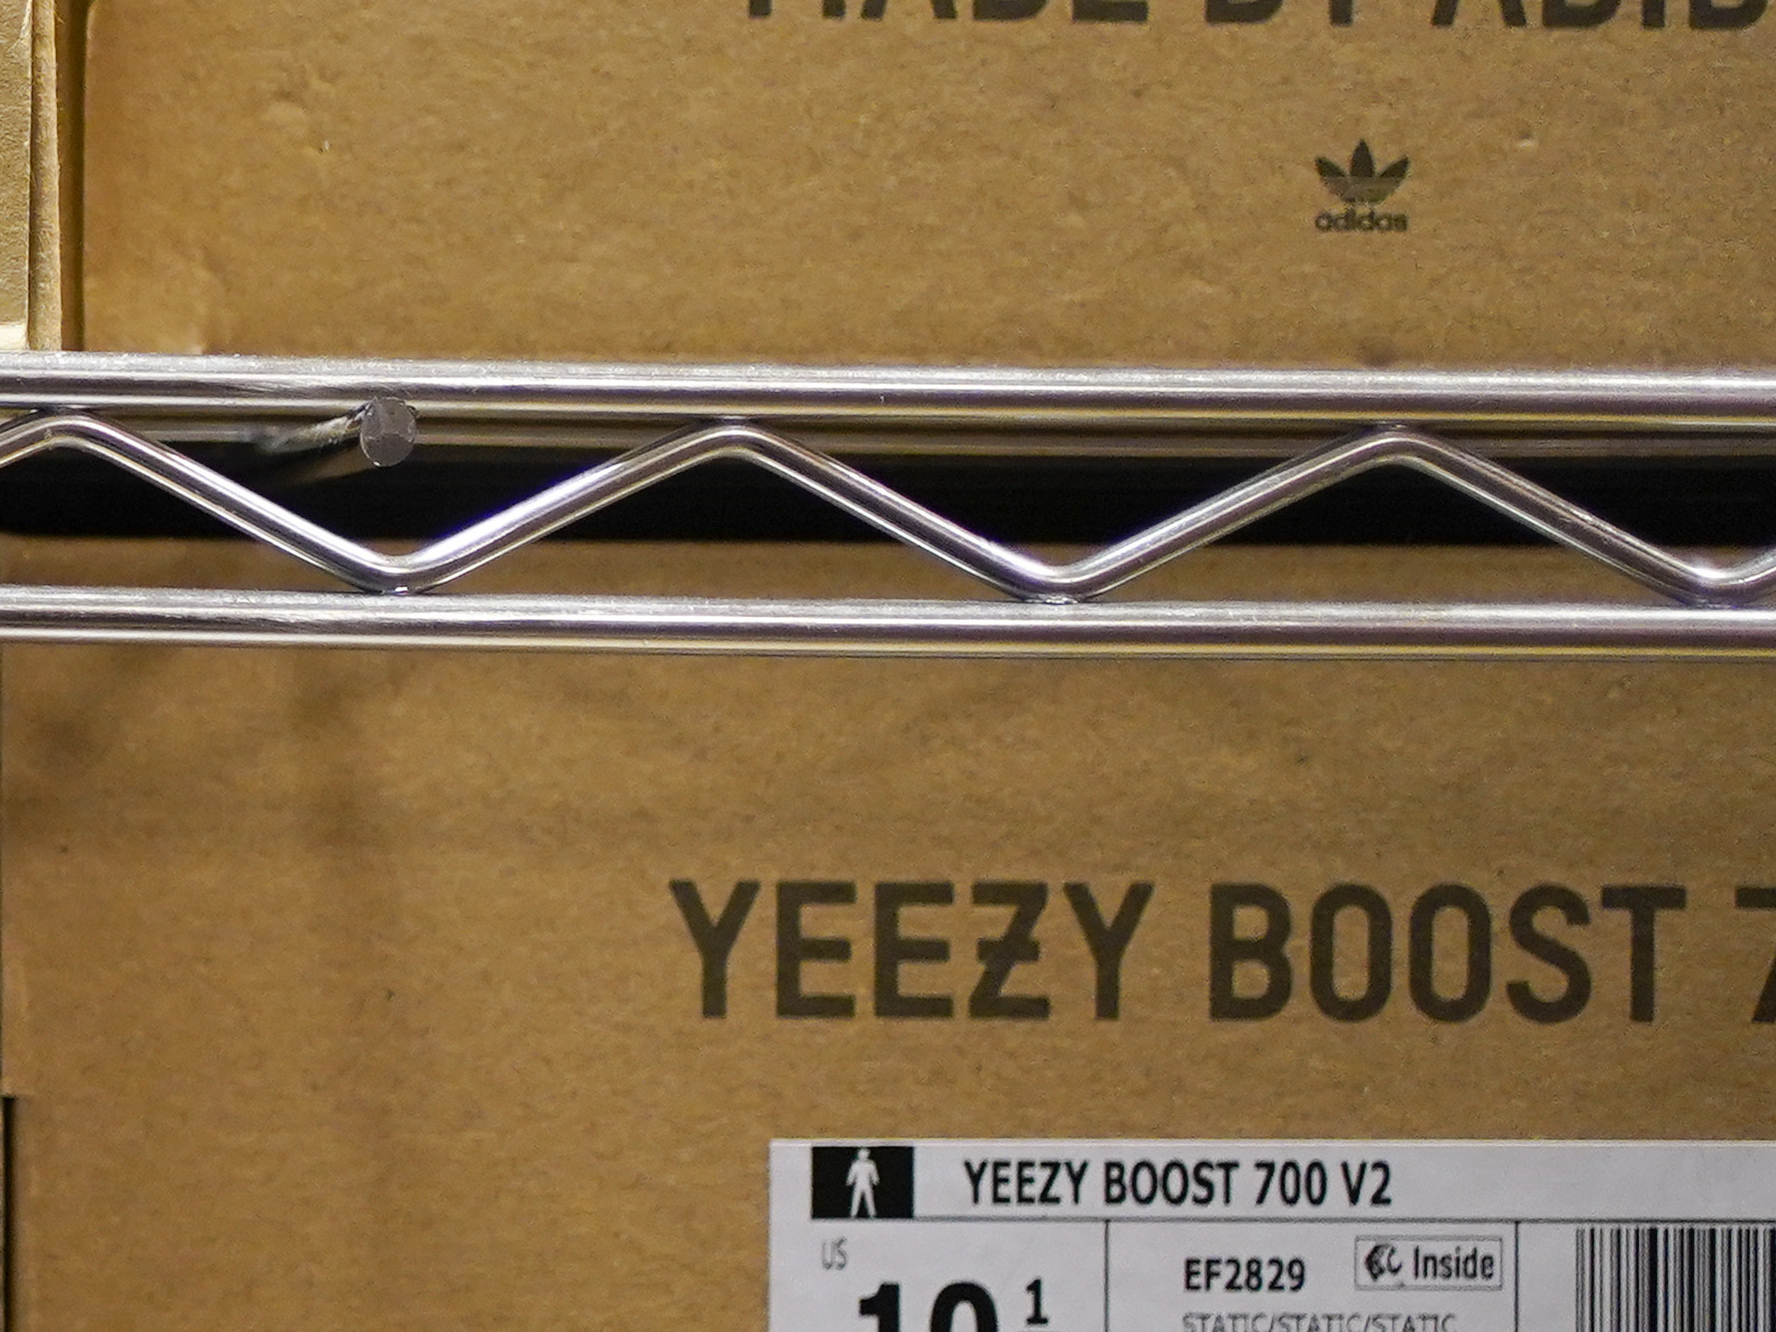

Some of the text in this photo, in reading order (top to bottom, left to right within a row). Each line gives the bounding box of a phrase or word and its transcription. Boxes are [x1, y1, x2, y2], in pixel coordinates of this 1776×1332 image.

[1315, 208, 1407, 232] adidas
[670, 881, 1153, 1021] YEEZY
[1210, 884, 1687, 1024] BOOST
[964, 1160, 1391, 1206] YEEZY BOOST 700 V2
[1185, 1247, 1494, 1292] EF2829 Inside
